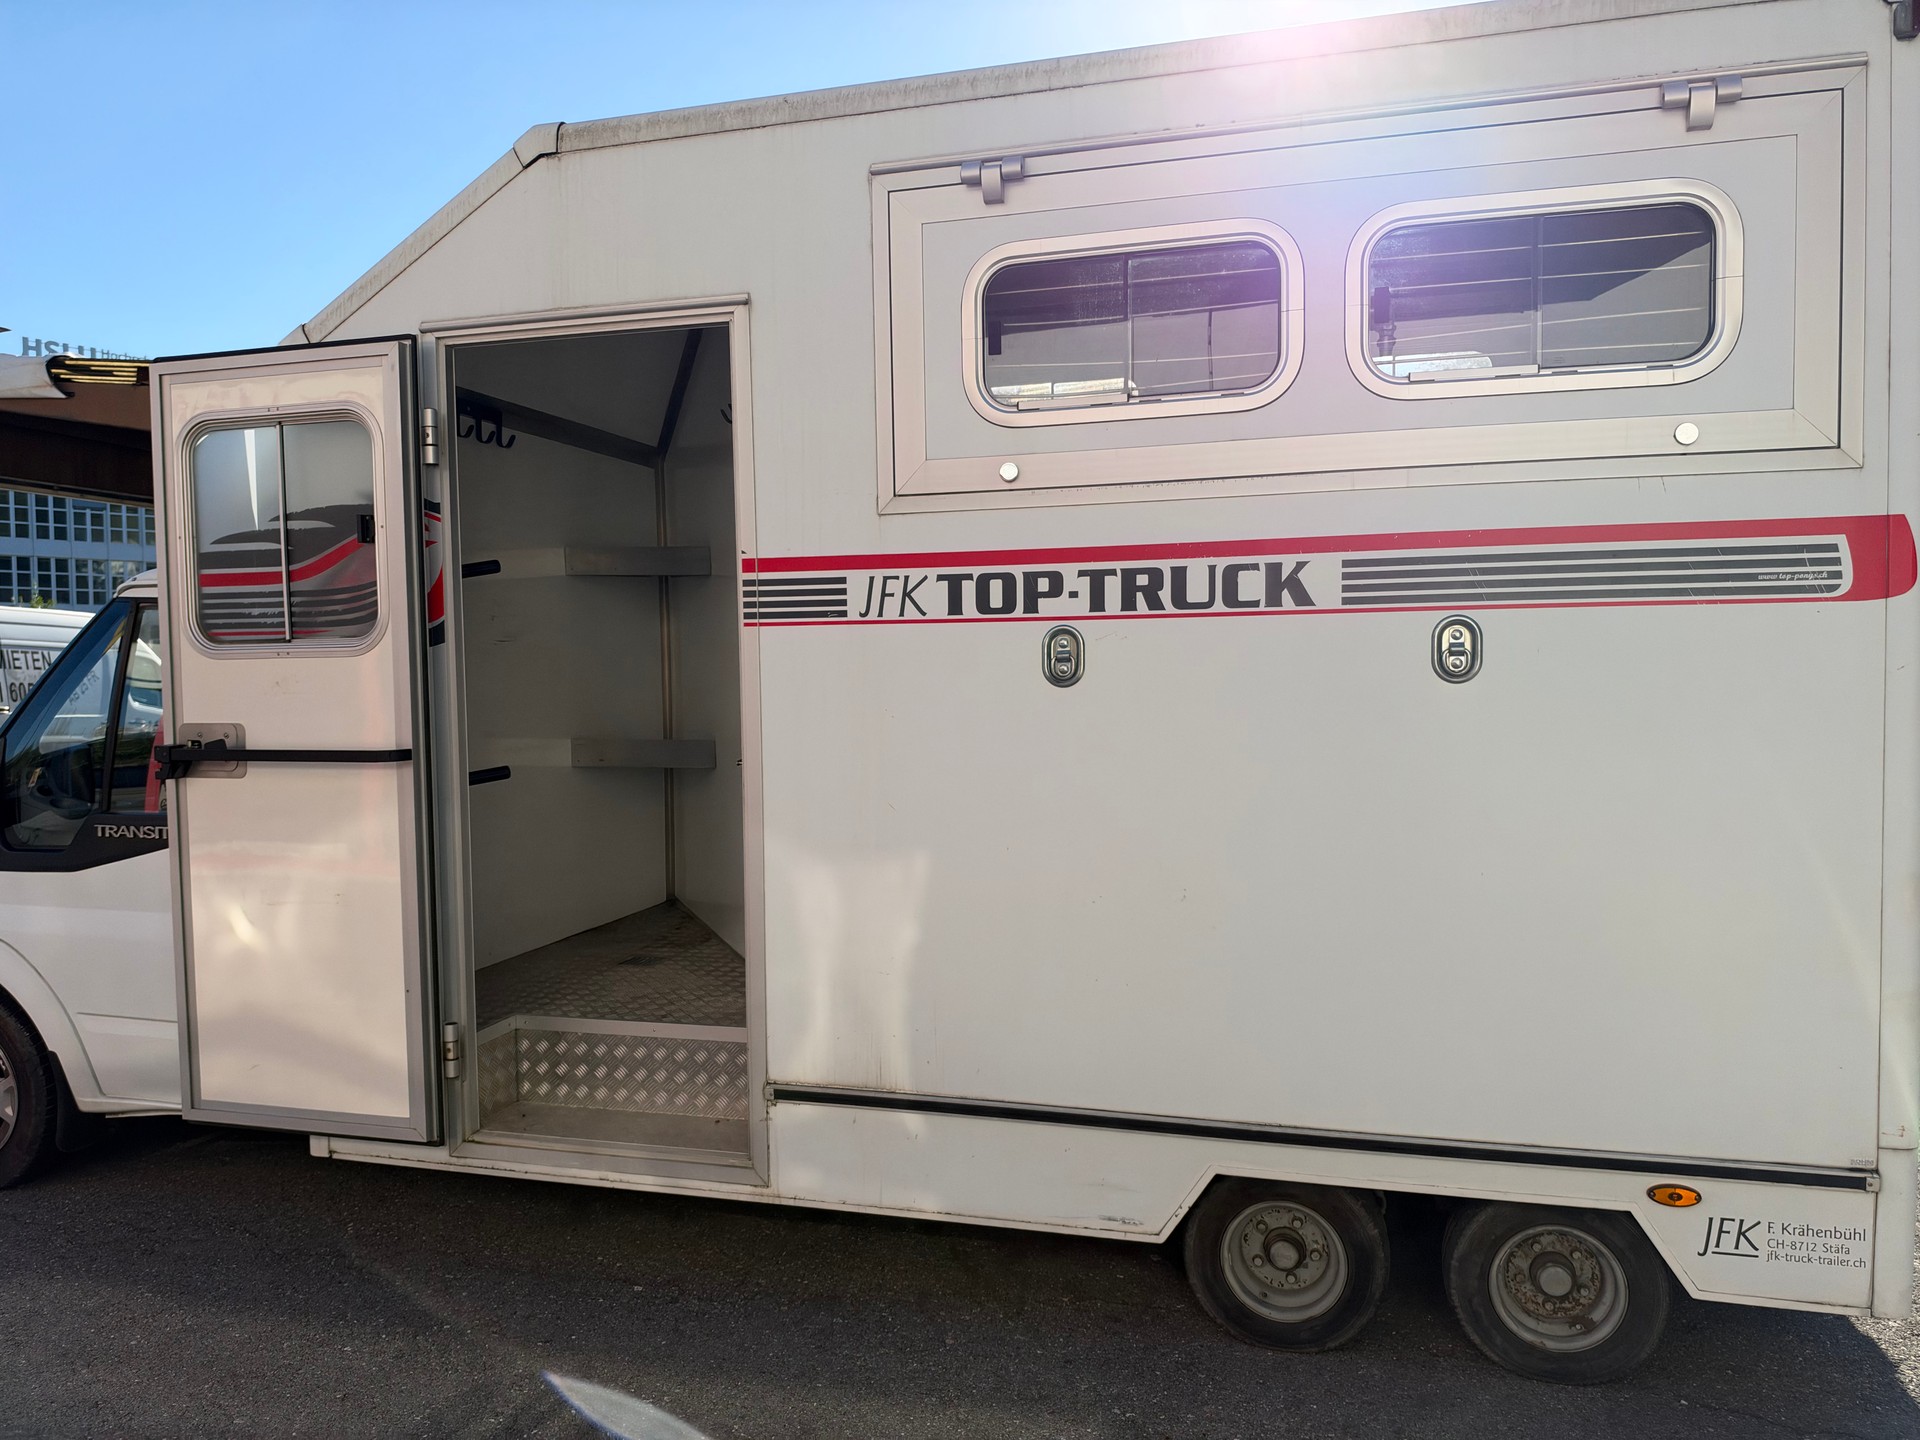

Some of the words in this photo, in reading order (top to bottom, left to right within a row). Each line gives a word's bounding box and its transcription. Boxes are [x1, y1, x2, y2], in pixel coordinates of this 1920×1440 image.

[859, 574, 928, 618] JFK
[936, 560, 1317, 616] TOP-TRUCK
[93, 824, 168, 839] TRANSIT
[1697, 1216, 1761, 1257] JFK
[1767, 1221, 1775, 1235] F.
[1781, 1222, 1867, 1242] Krähenbühl
[1766, 1238, 1818, 1253] CH-8712
[1822, 1242, 1850, 1255] Stäfa
[1766, 1251, 1867, 1269] jfk-truck-trailer.ch
